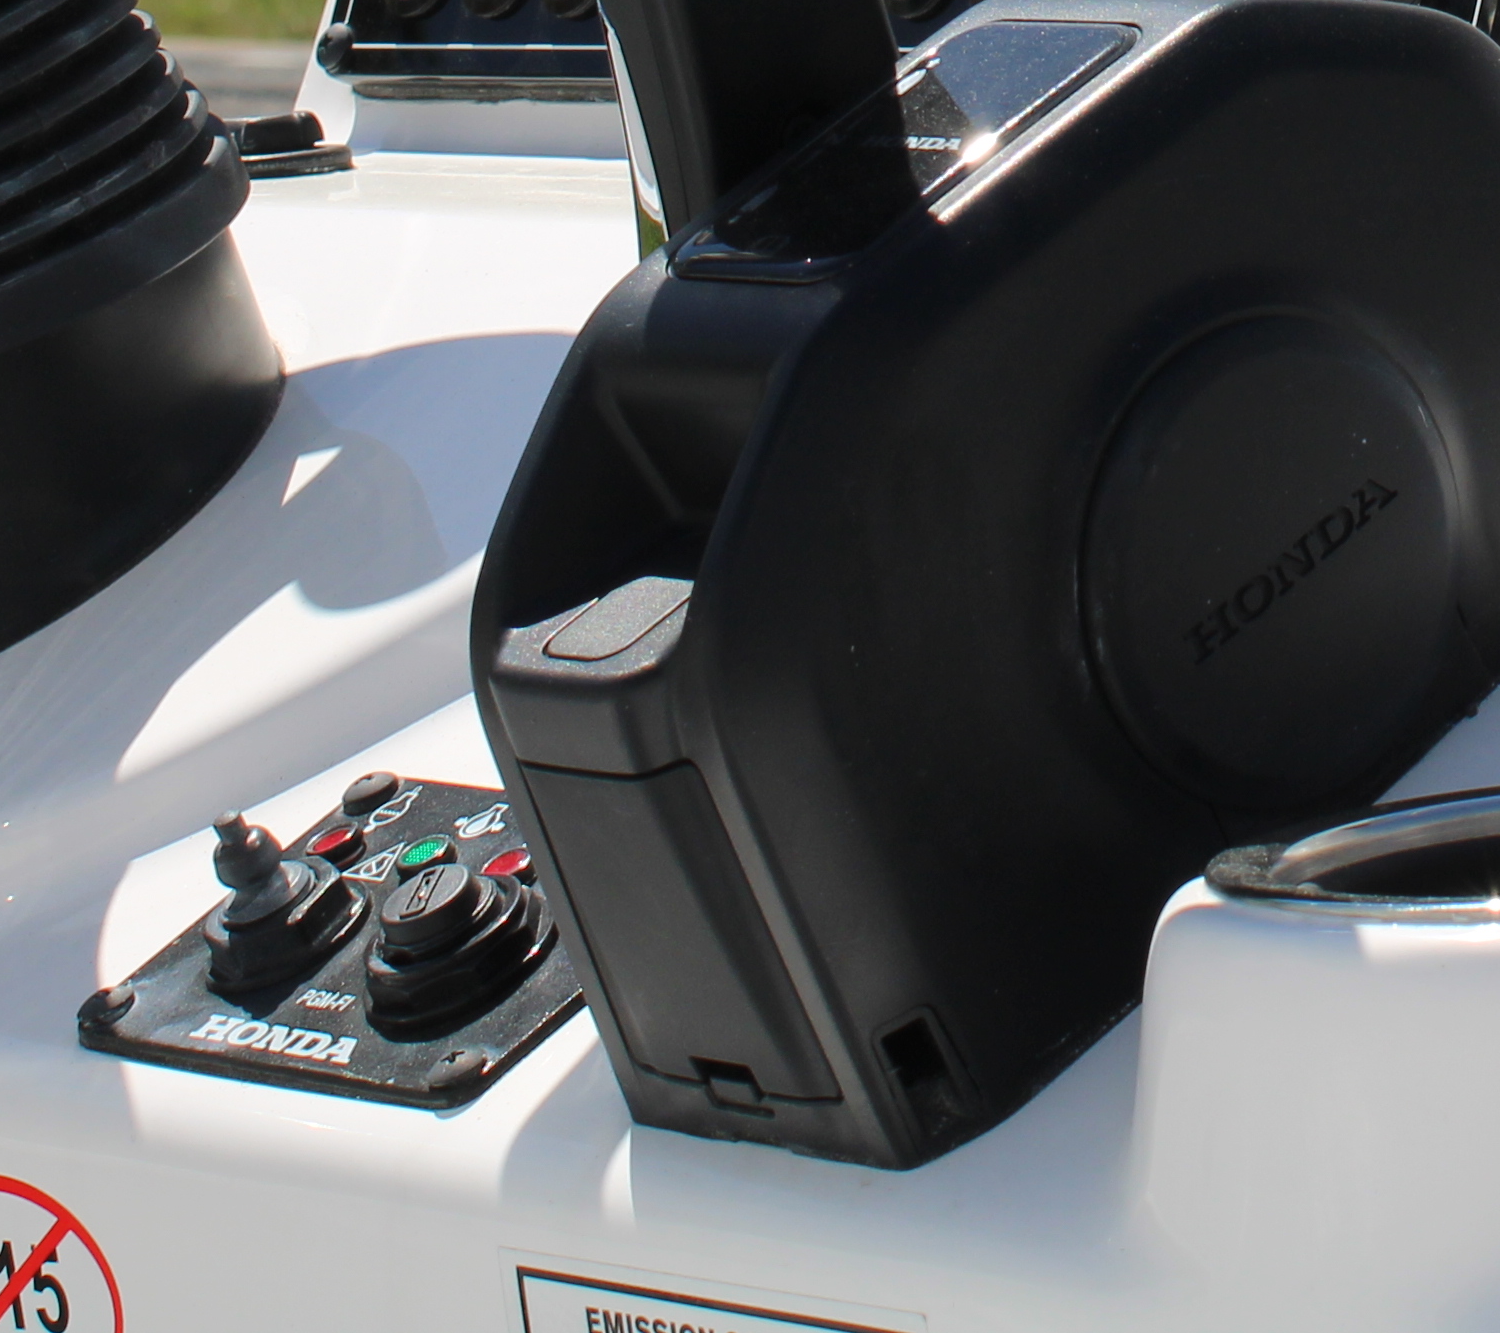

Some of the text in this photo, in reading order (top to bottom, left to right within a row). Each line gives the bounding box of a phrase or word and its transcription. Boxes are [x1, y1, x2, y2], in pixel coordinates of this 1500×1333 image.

[904, 136, 962, 151] NDA
[1183, 478, 1399, 666] HONDA
[295, 988, 357, 1012] PGM-FI
[189, 1013, 359, 1067] HONDA
[586, 1307, 714, 1333] EMISS
